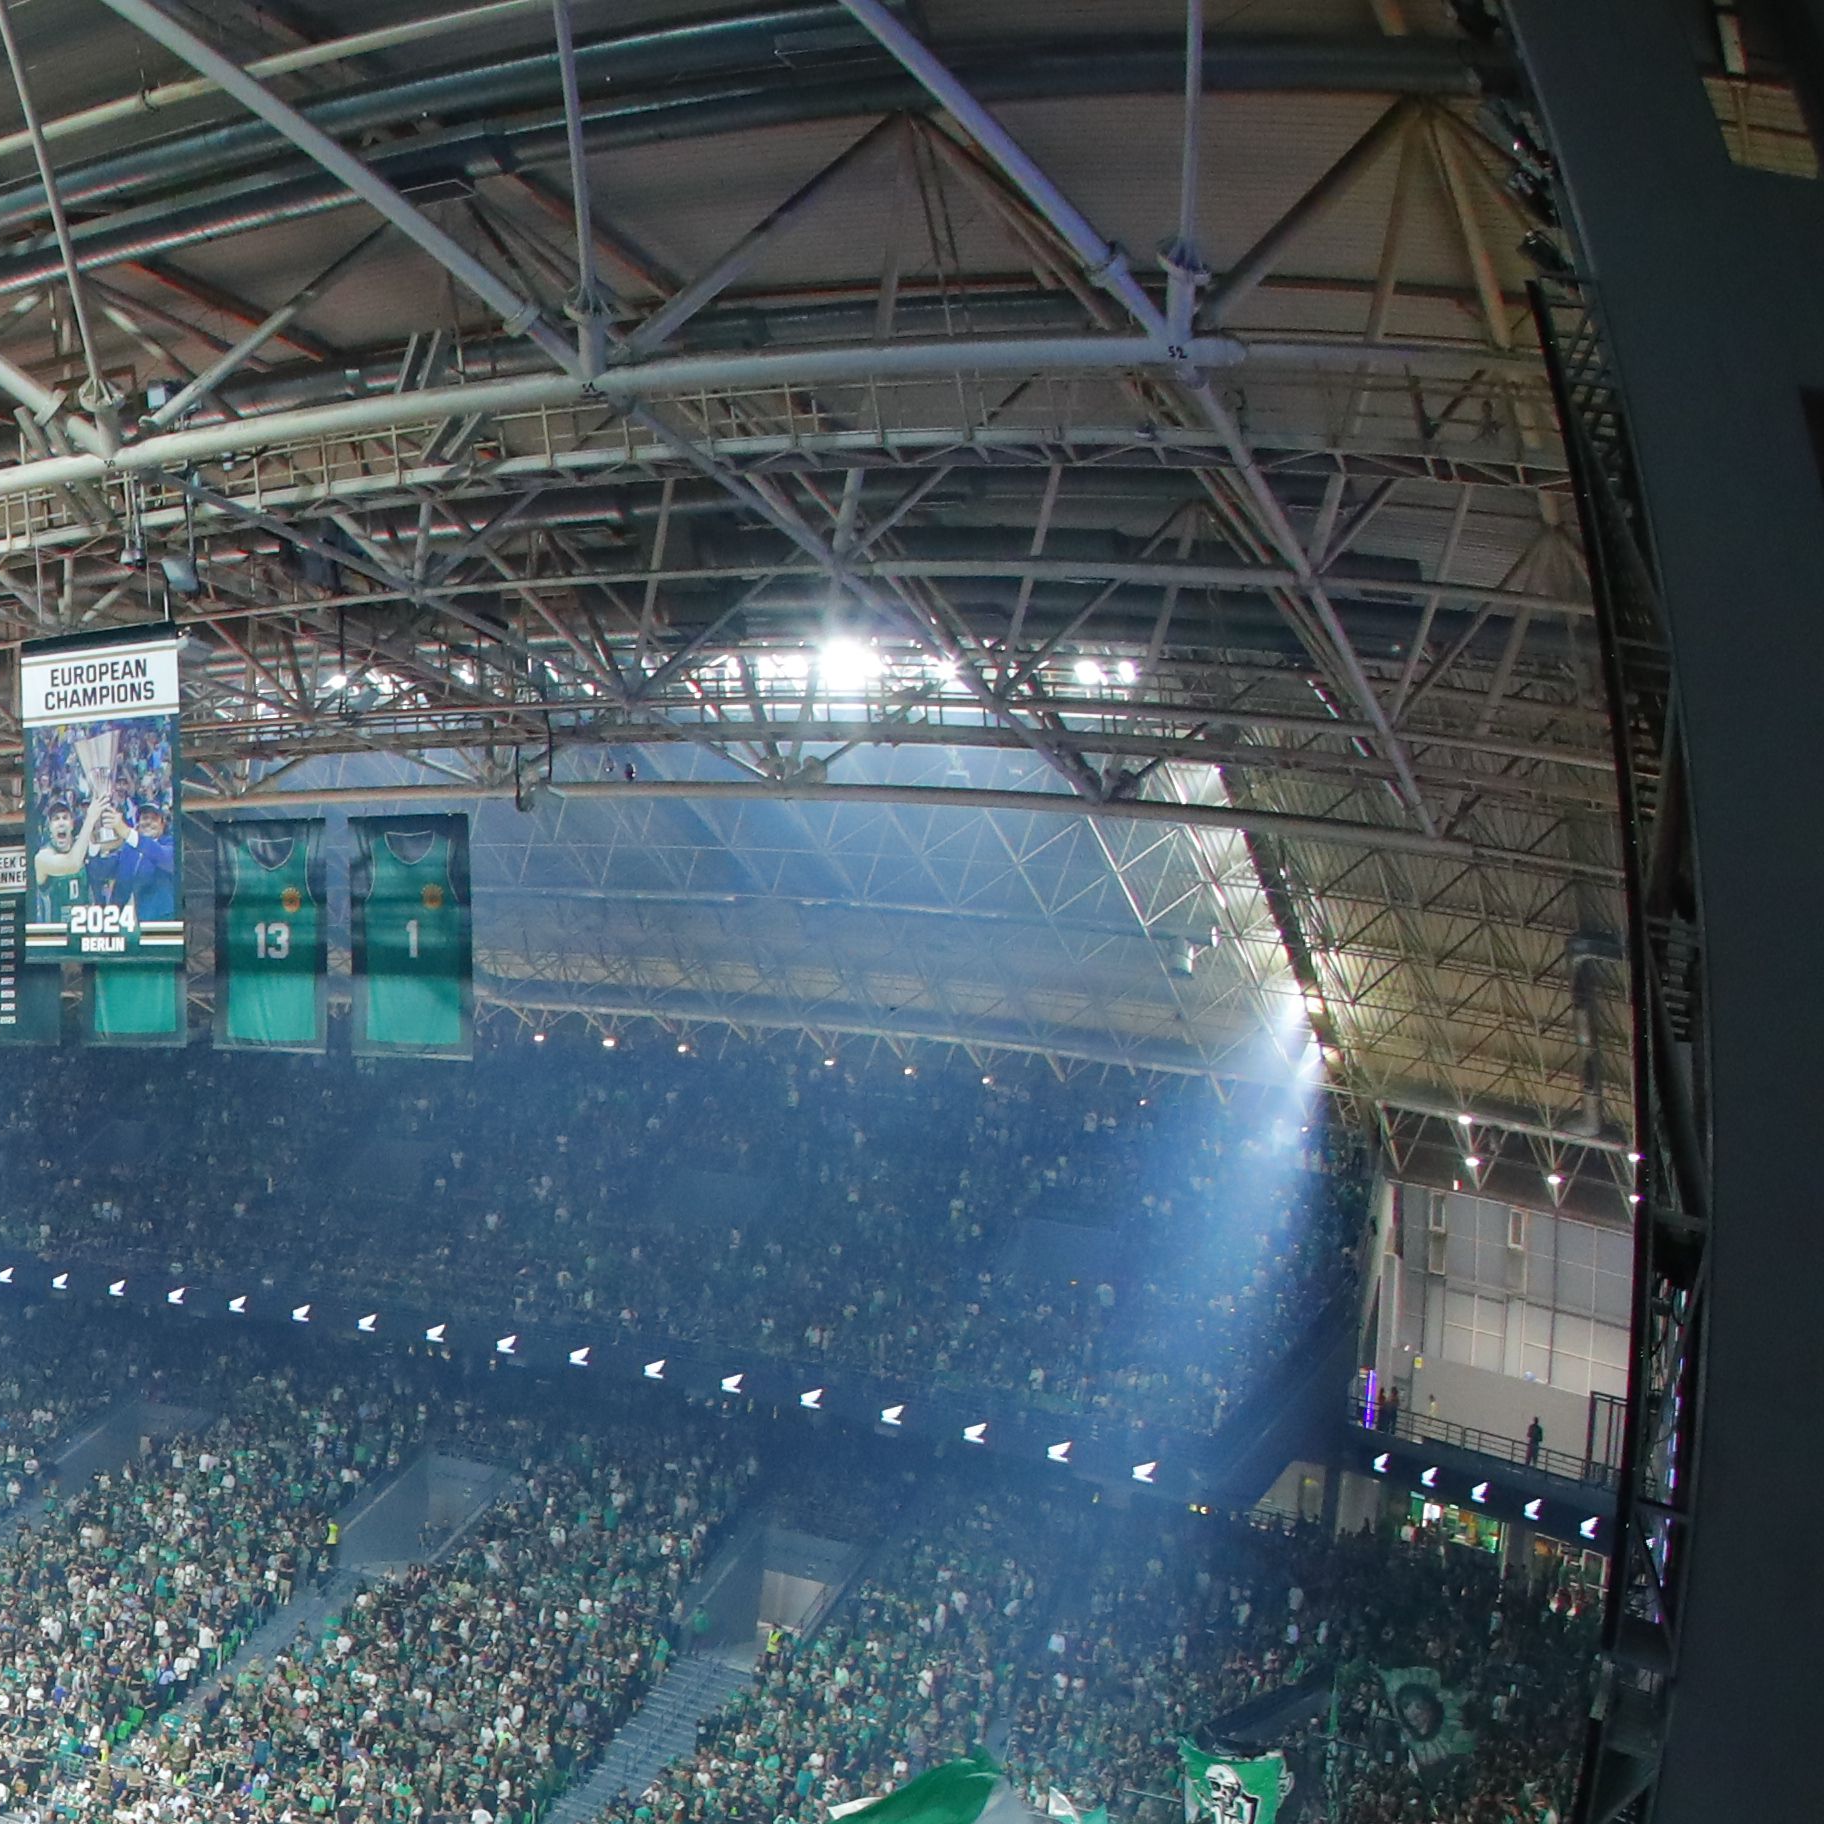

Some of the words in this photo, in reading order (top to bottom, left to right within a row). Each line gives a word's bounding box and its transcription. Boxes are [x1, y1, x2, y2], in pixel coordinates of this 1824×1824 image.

[51, 658, 147, 687] EUROPEAN
[44, 681, 155, 711] CHAMPIONS
[70, 905, 136, 934] 2024
[81, 936, 125, 952] BERLIN
[254, 922, 290, 959] 13
[405, 919, 419, 958] 1
